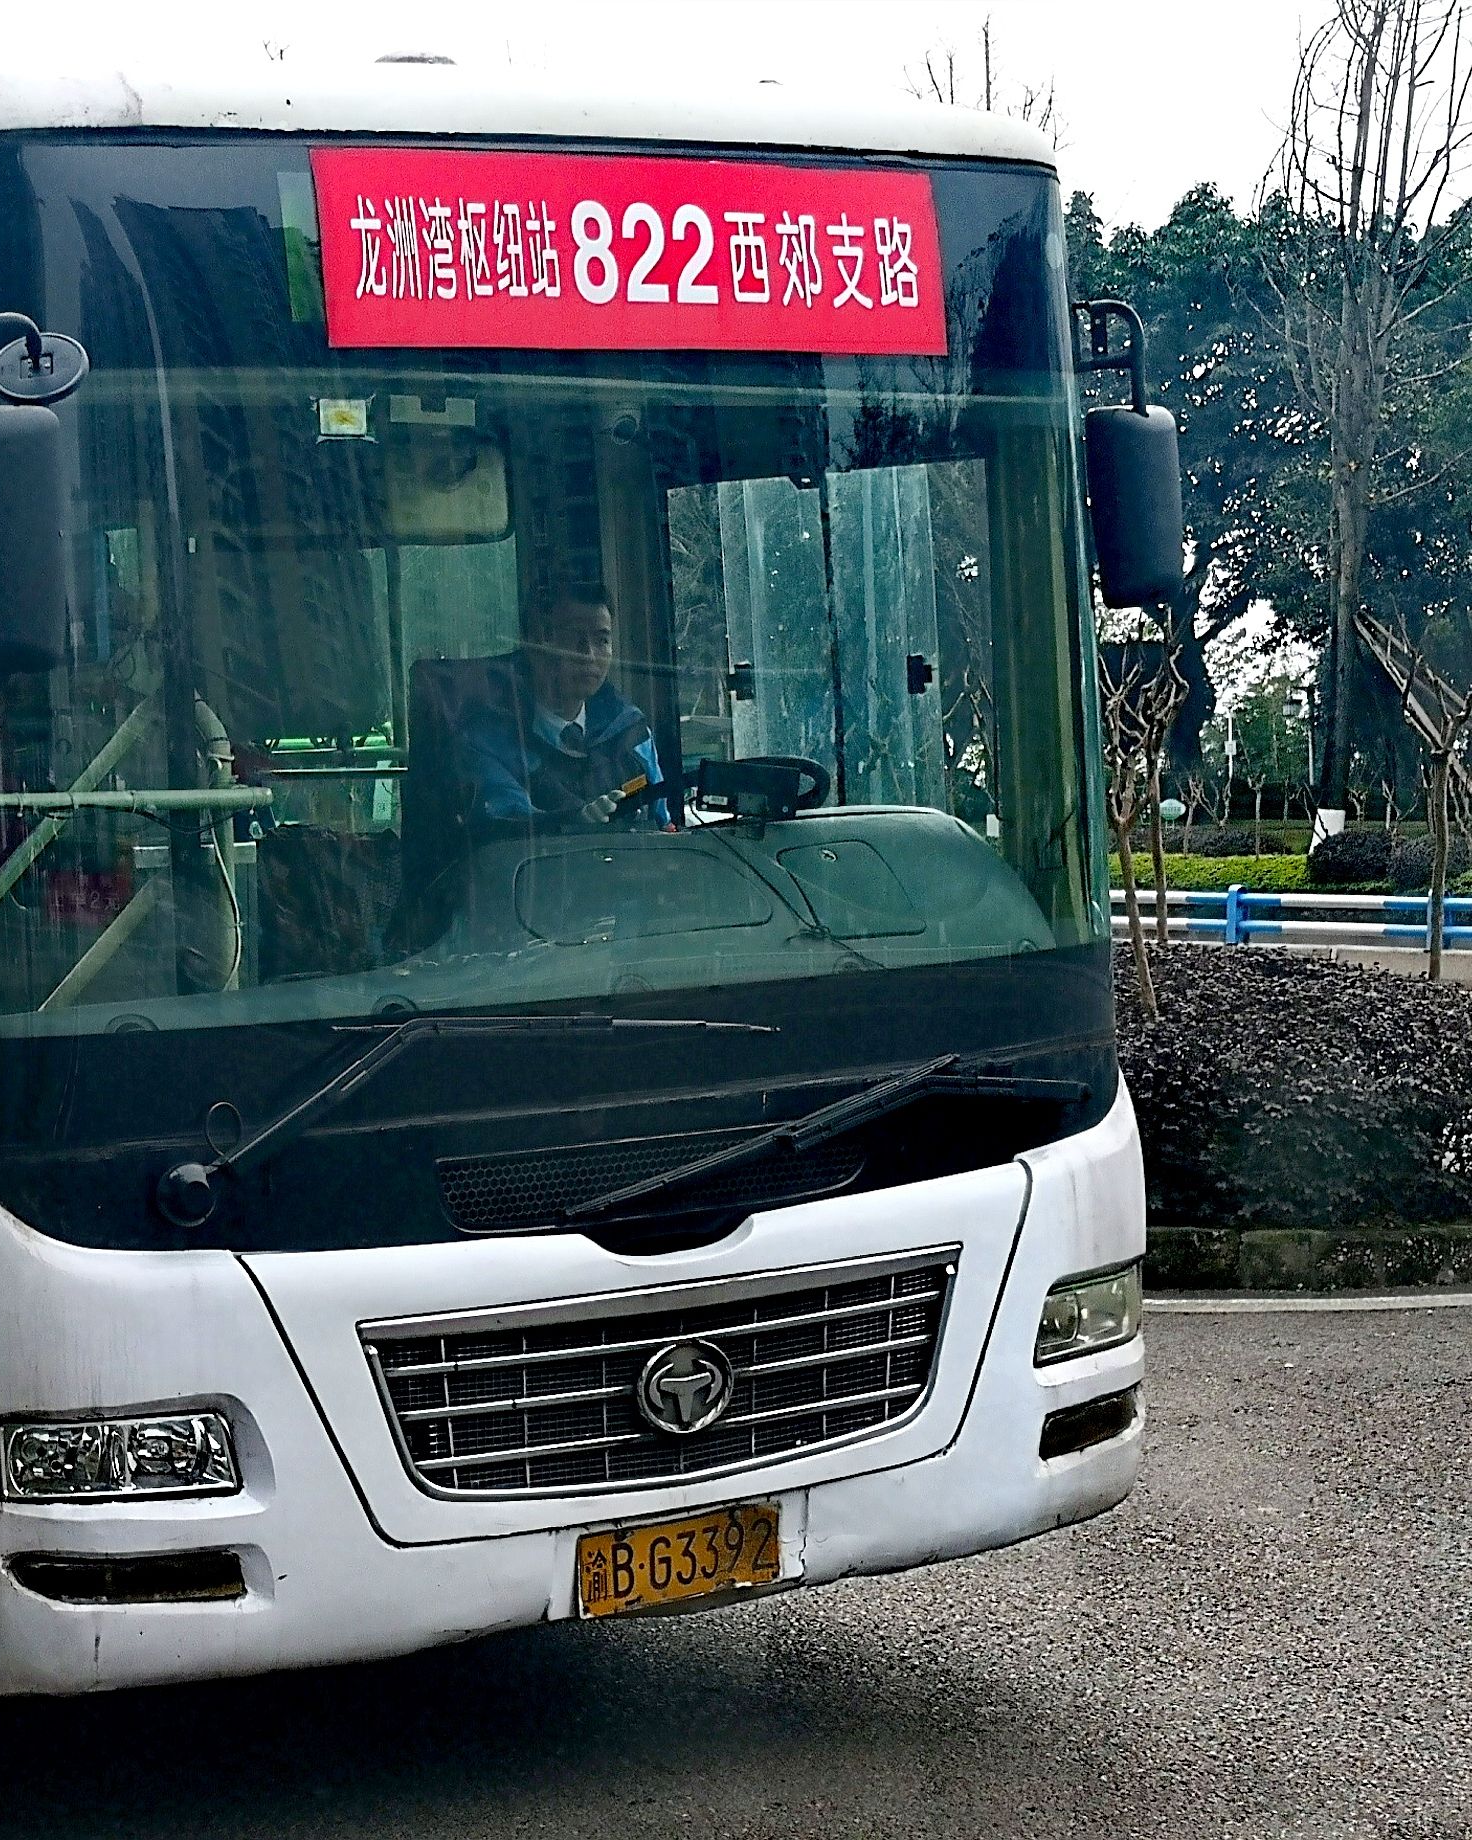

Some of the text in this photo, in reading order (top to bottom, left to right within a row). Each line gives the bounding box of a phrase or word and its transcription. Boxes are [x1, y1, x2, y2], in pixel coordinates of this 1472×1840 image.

[350, 193, 920, 310] 龙洲湾枢纽站 822 西郊支路
